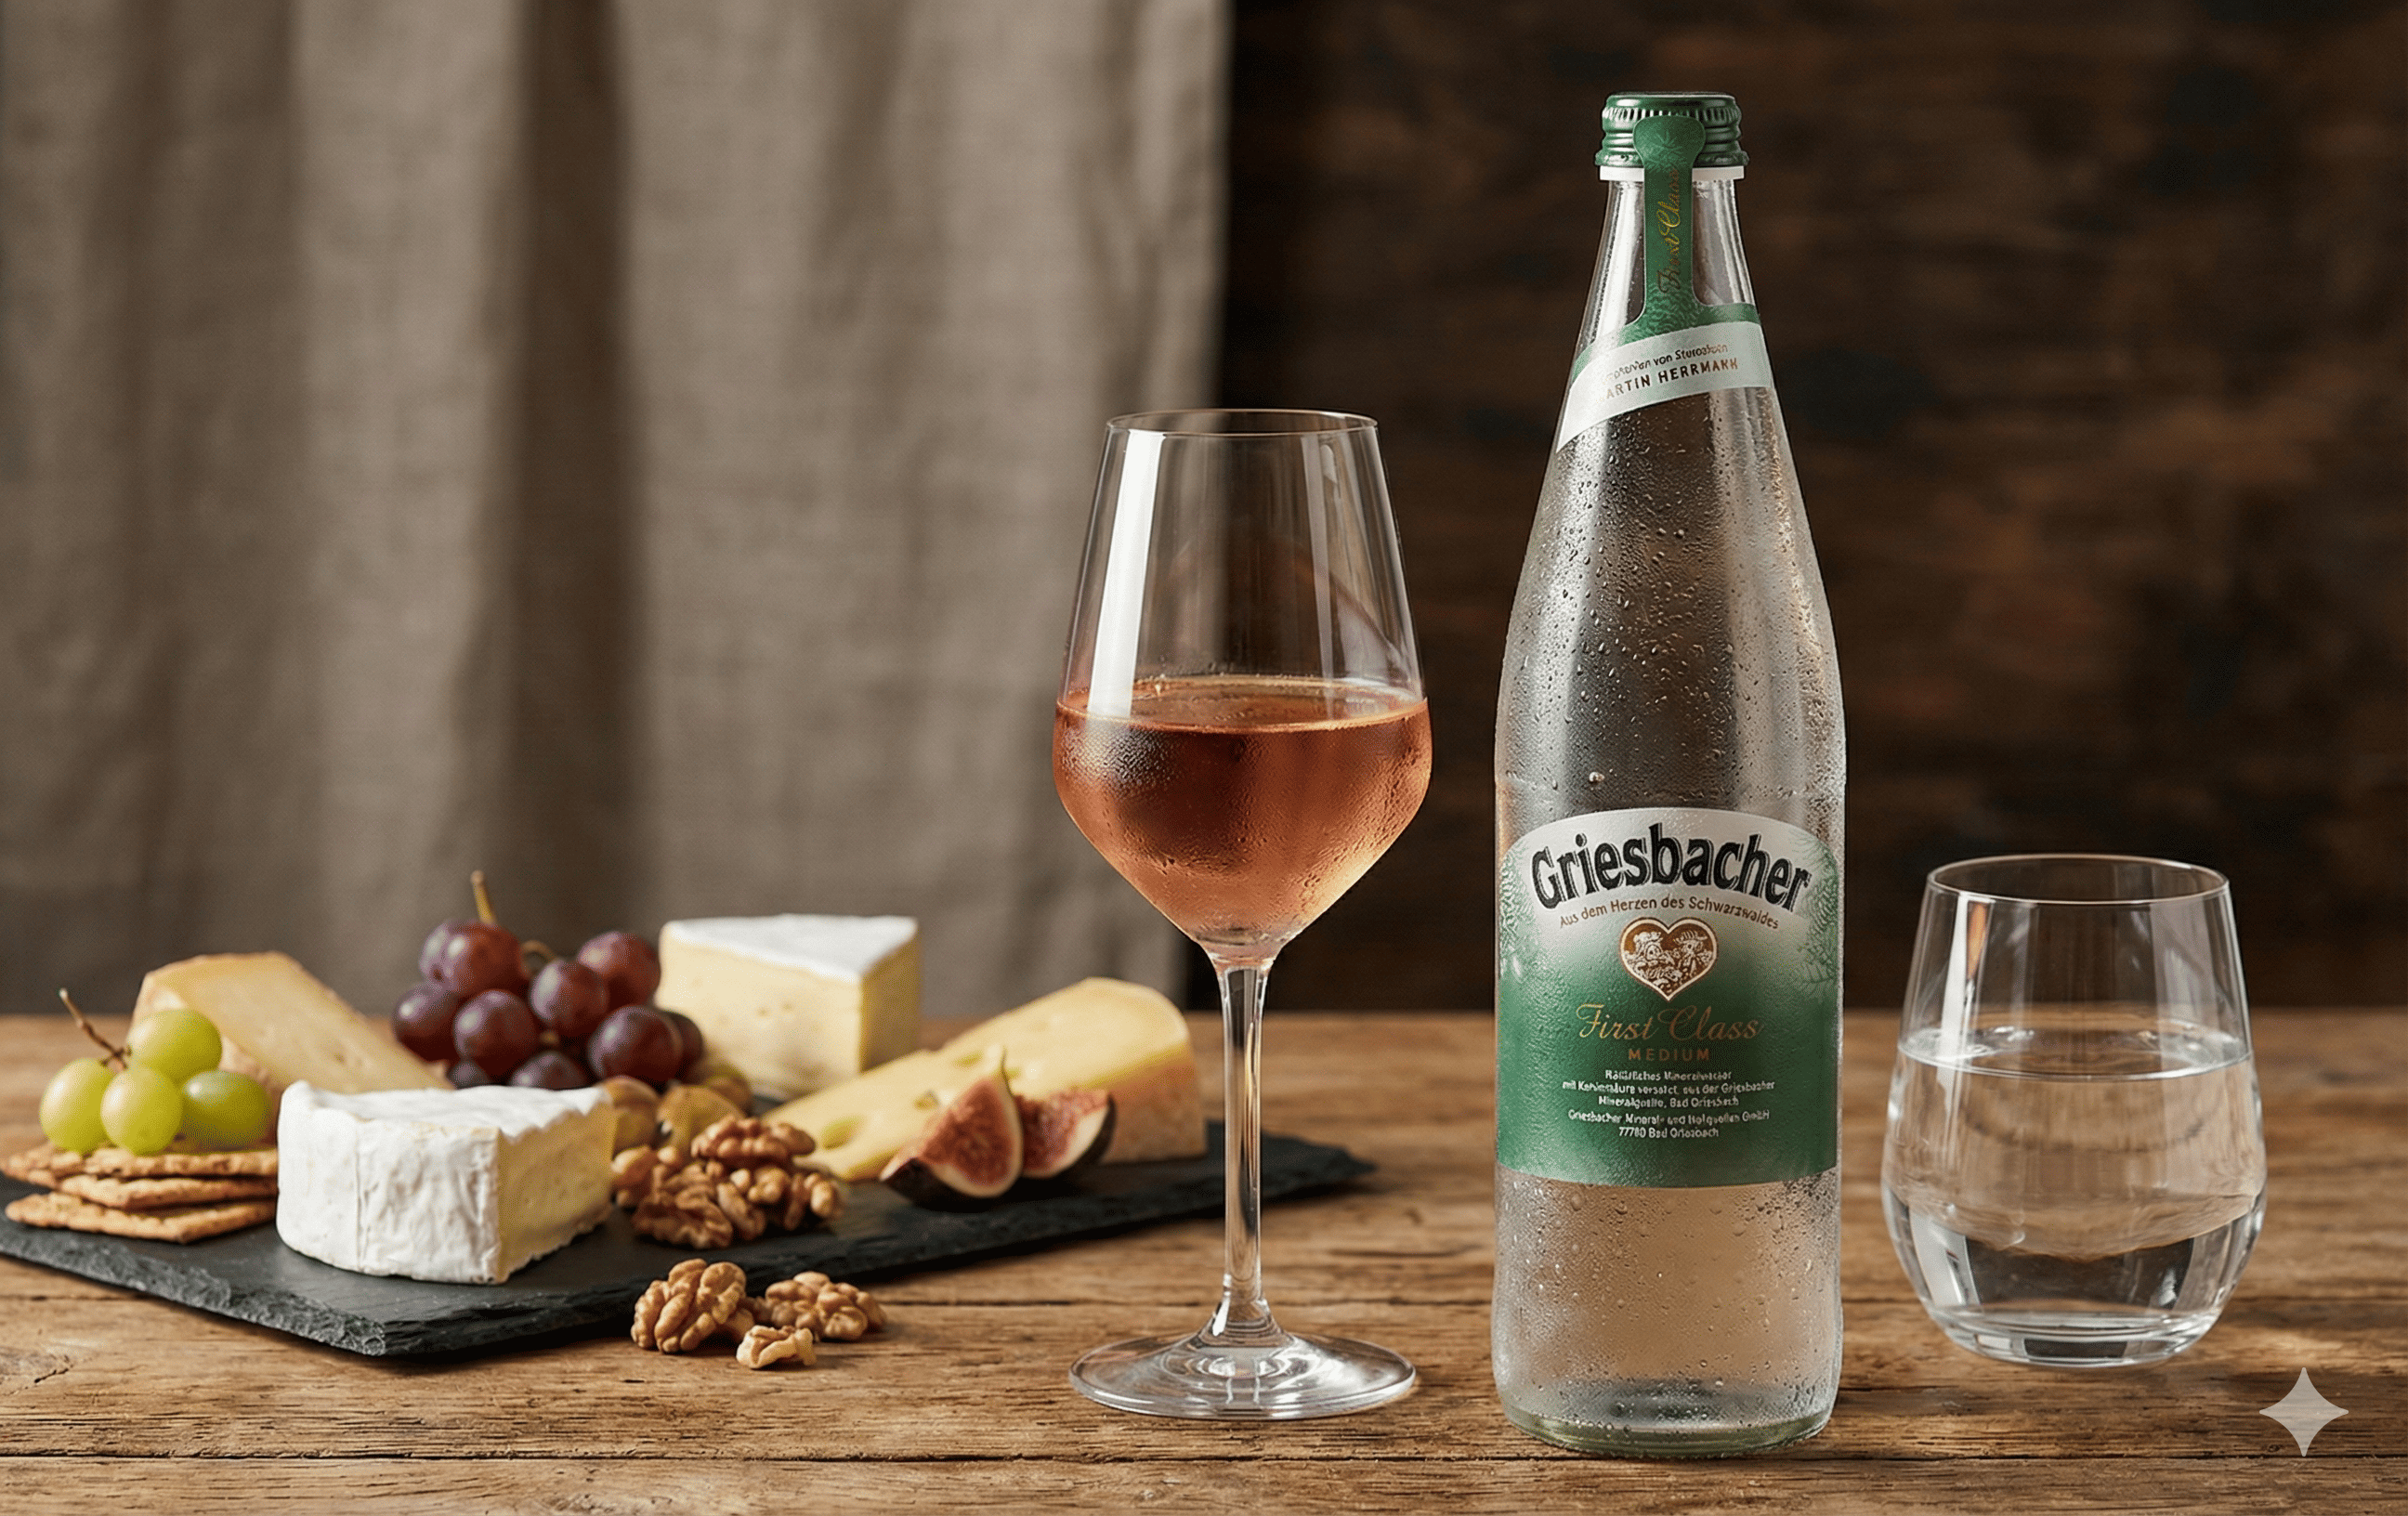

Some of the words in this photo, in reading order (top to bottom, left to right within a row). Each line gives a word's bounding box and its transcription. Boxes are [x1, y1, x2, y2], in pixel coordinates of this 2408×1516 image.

[1654, 354, 1673, 367] von
[1600, 374, 1651, 400] ARTIN
[1532, 822, 1812, 913] Griesbacher
[1560, 913, 1578, 928] Aus
[1581, 905, 1607, 920] dem
[1611, 898, 1656, 912] Herzen
[1661, 895, 1684, 908] des
[1576, 1003, 1659, 1039] First
[1657, 1005, 1764, 1040] Class
[1629, 1049, 1709, 1061] MEDIUM
